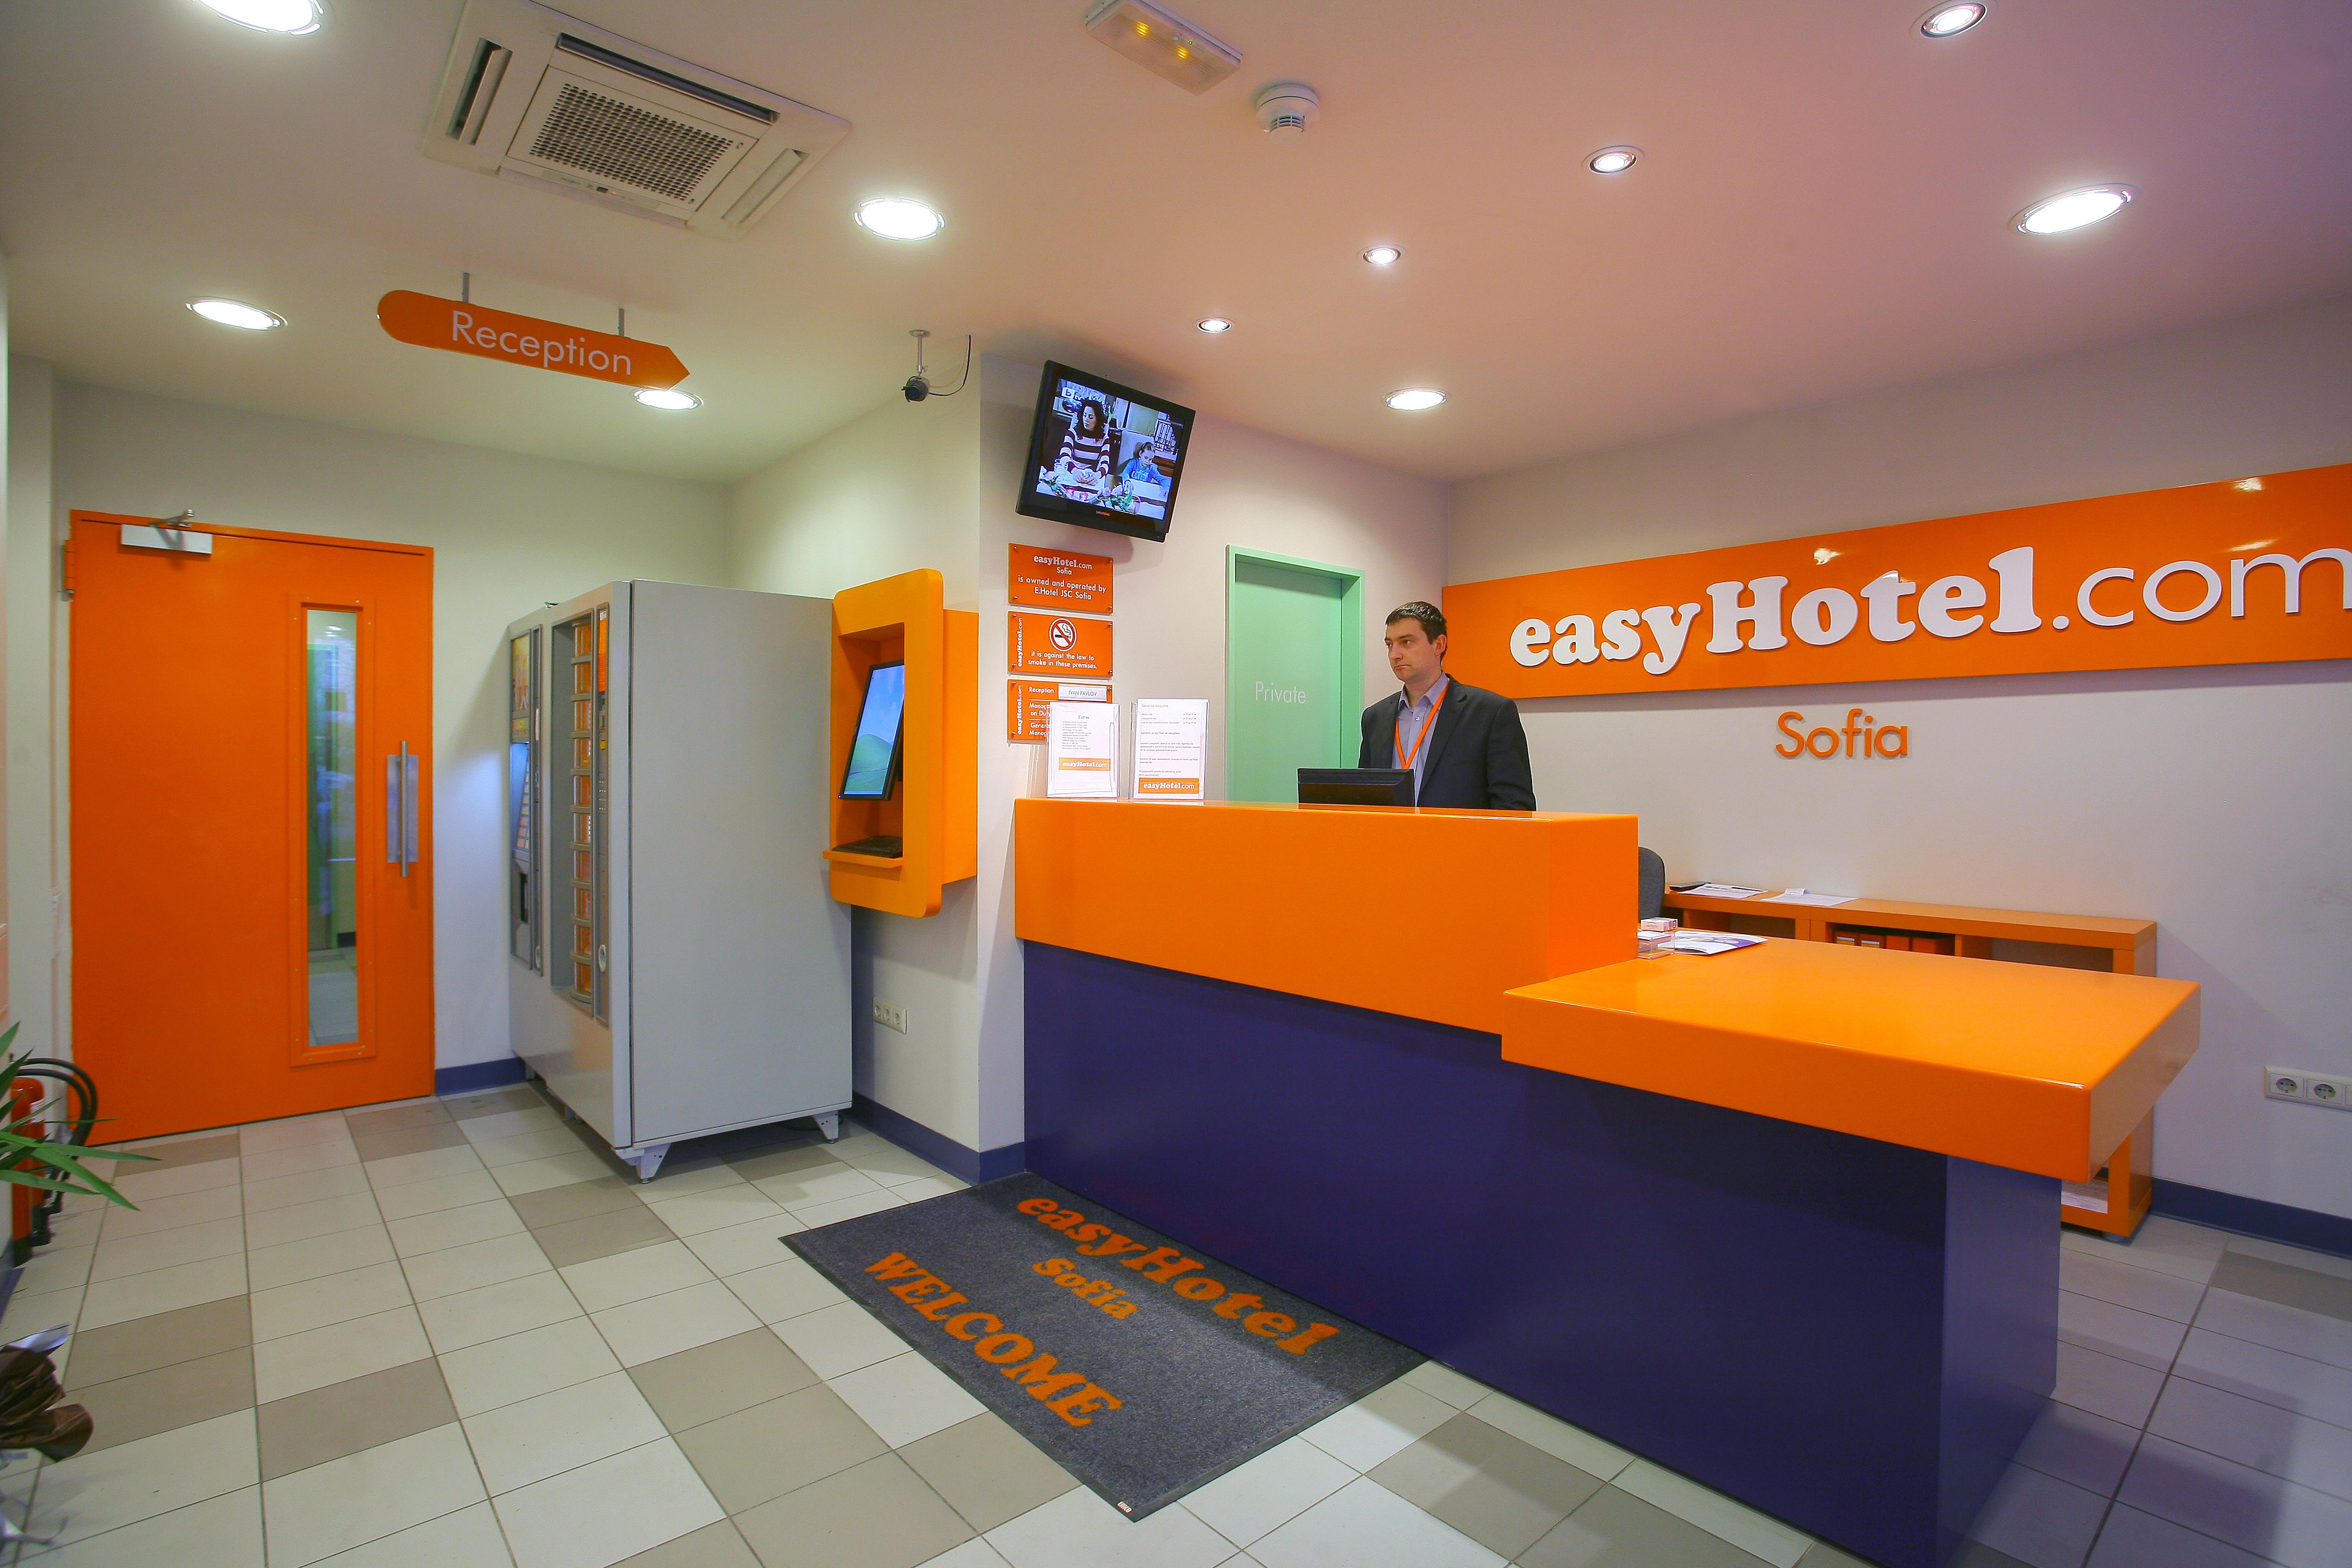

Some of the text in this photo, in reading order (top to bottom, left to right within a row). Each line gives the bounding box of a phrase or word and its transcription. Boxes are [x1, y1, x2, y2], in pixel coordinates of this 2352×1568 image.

[452, 310, 631, 375] Reception
[1033, 555, 1092, 570] easyHotel.com
[1056, 567, 1072, 575] Sofia
[1026, 577, 1049, 585] owned
[1067, 582, 1096, 591] operated
[1098, 584, 1107, 593] by
[1034, 586, 1092, 600] E.Hotel JSC Sofia
[1509, 546, 2352, 675] easyHotel.com
[1044, 652, 1064, 660] against
[1255, 680, 1306, 704] Private
[1776, 708, 1908, 758] Sofia
[1016, 1197, 1339, 1355] easyHotel
[864, 1252, 1123, 1427] WELCOME
